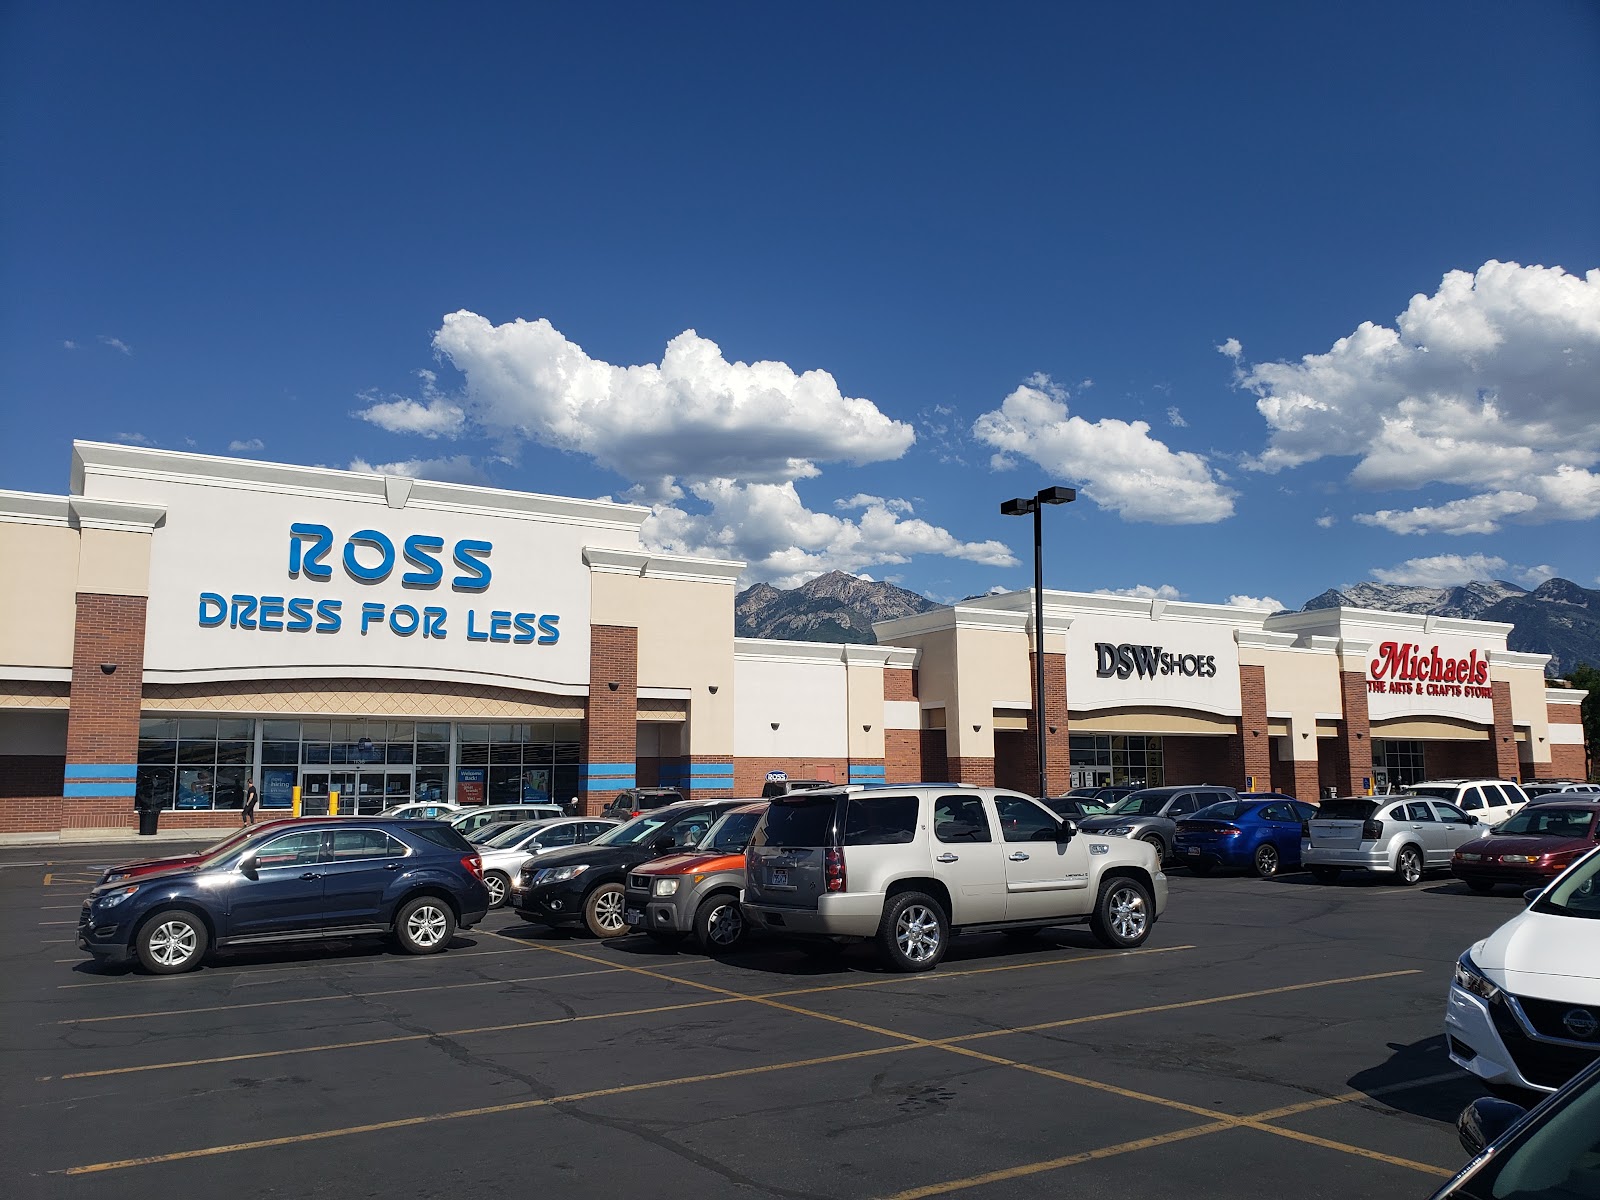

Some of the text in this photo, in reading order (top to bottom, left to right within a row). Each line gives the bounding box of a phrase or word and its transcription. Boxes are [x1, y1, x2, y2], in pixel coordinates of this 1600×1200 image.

[289, 522, 493, 592] ROSS
[199, 592, 560, 645] DRESS FOR LESS
[1095, 642, 1216, 681] DSW SHOES
[1370, 641, 1488, 684] Michaels
[1366, 681, 1493, 699] THE ARTS & CRAFTS STORE
[768, 773, 786, 781] ROSS
